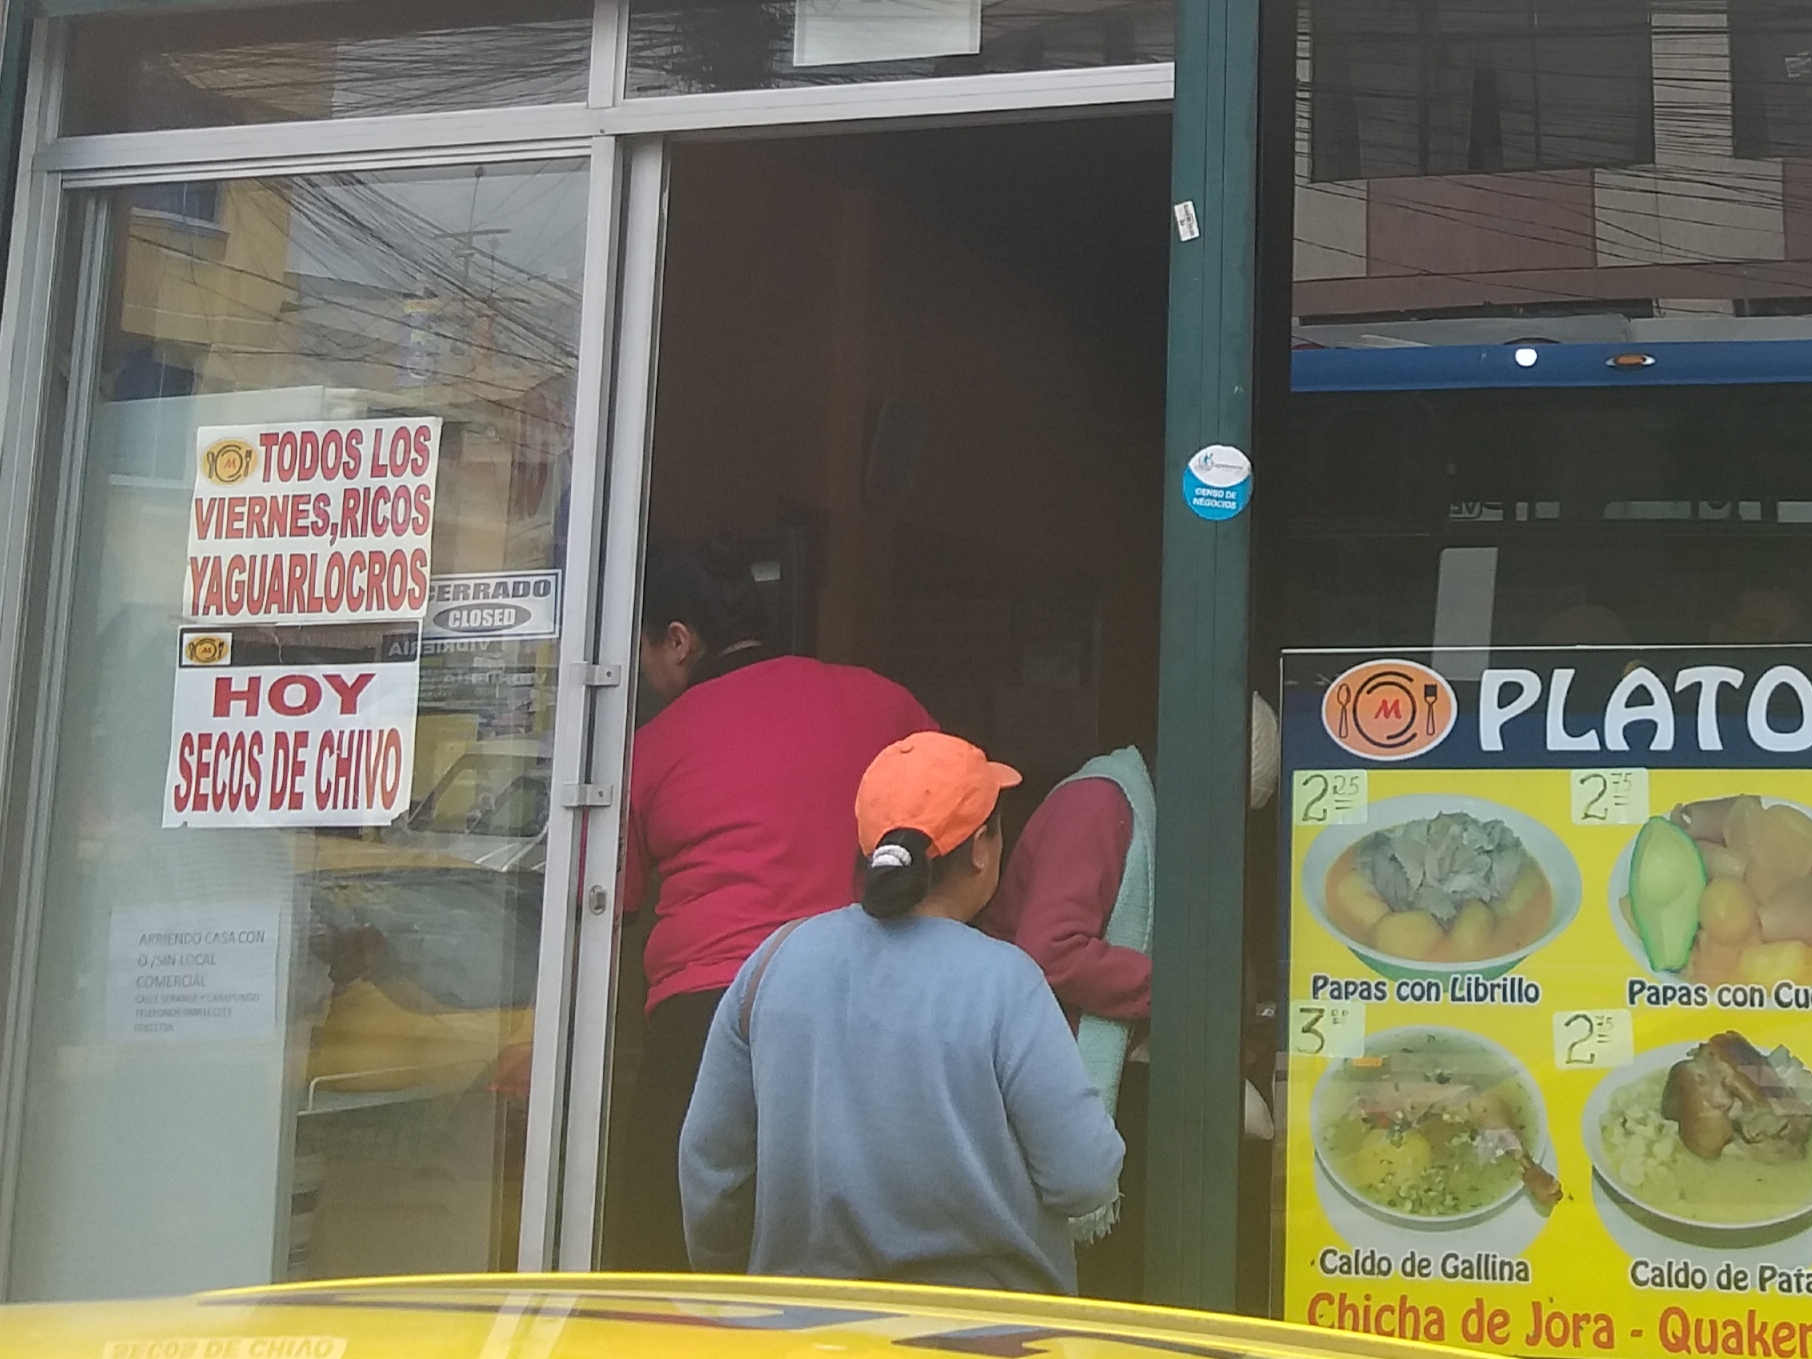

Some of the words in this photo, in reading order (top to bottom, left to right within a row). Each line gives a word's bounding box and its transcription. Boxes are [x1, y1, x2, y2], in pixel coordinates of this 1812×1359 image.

[259, 428, 364, 482] TODOS
[370, 425, 432, 478] LOS
[1192, 498, 1238, 510] NEGOCIOS
[1195, 487, 1224, 498] CENSO
[1226, 490, 1238, 499] DE
[190, 548, 428, 617] YAGUARLOCROS
[448, 608, 516, 628] CLOSED
[213, 673, 377, 717] HOY
[174, 729, 264, 813] SECOS
[269, 729, 309, 811] DE
[315, 727, 402, 811] CHIVO
[205, 931, 236, 944] CASA
[238, 930, 265, 943] CON
[180, 952, 217, 966] LOCAL
[136, 974, 207, 989] COMERCIAL
[1312, 975, 1388, 1002] Papas
[1397, 980, 1440, 1002] con
[1450, 976, 1540, 1003] Librillo
[1628, 980, 1707, 1008] Papas
[1718, 985, 1766, 1008] con
[1319, 1249, 1392, 1278] Caldo
[1400, 1251, 1432, 1279] de
[1441, 1252, 1530, 1282] Gallina
[1631, 1259, 1706, 1289] Caldo
[1716, 1262, 1749, 1292] de
[1307, 1292, 1446, 1342] Chicha
[1461, 1298, 1511, 1346] de
[1525, 1300, 1615, 1349] Jora
